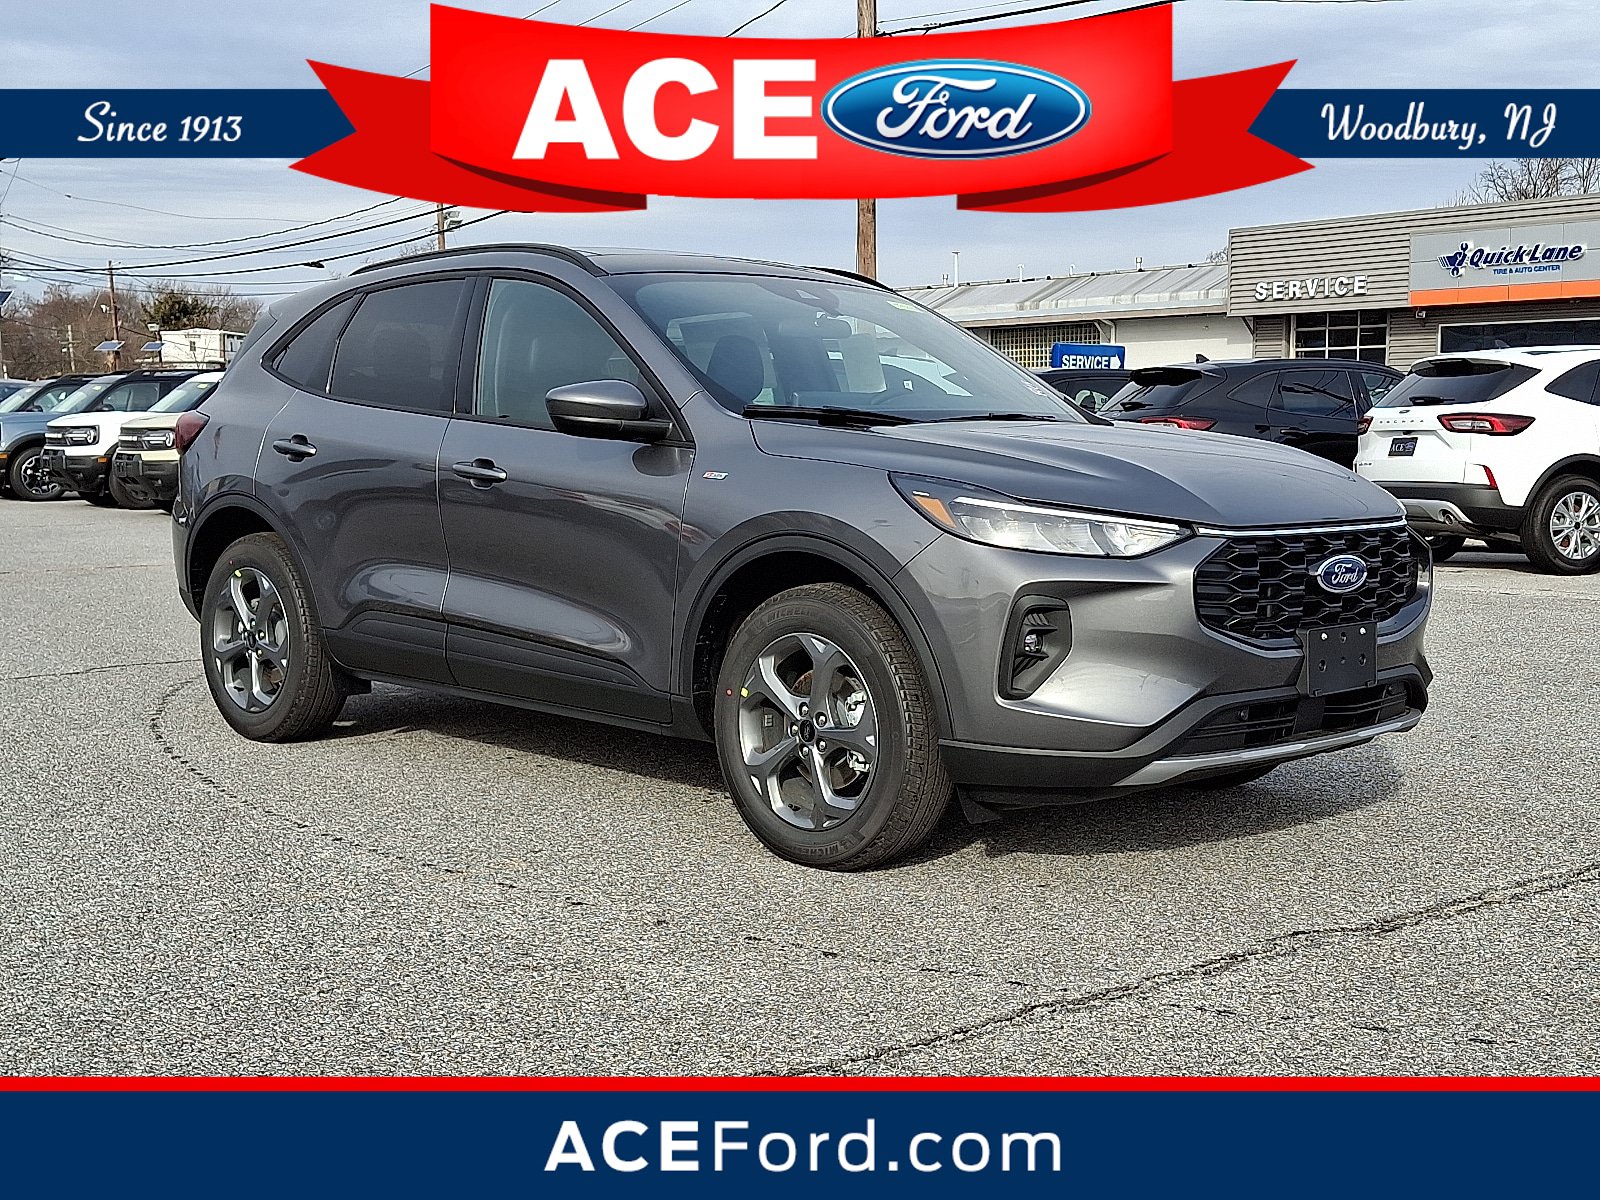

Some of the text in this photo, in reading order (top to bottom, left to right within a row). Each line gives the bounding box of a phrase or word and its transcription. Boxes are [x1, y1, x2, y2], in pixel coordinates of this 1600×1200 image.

[1533, 264, 1561, 273] CENTER
[1255, 275, 1368, 302] SERVICE
[1061, 354, 1109, 369] SERVICE
[1331, 563, 1359, 585] Ford
